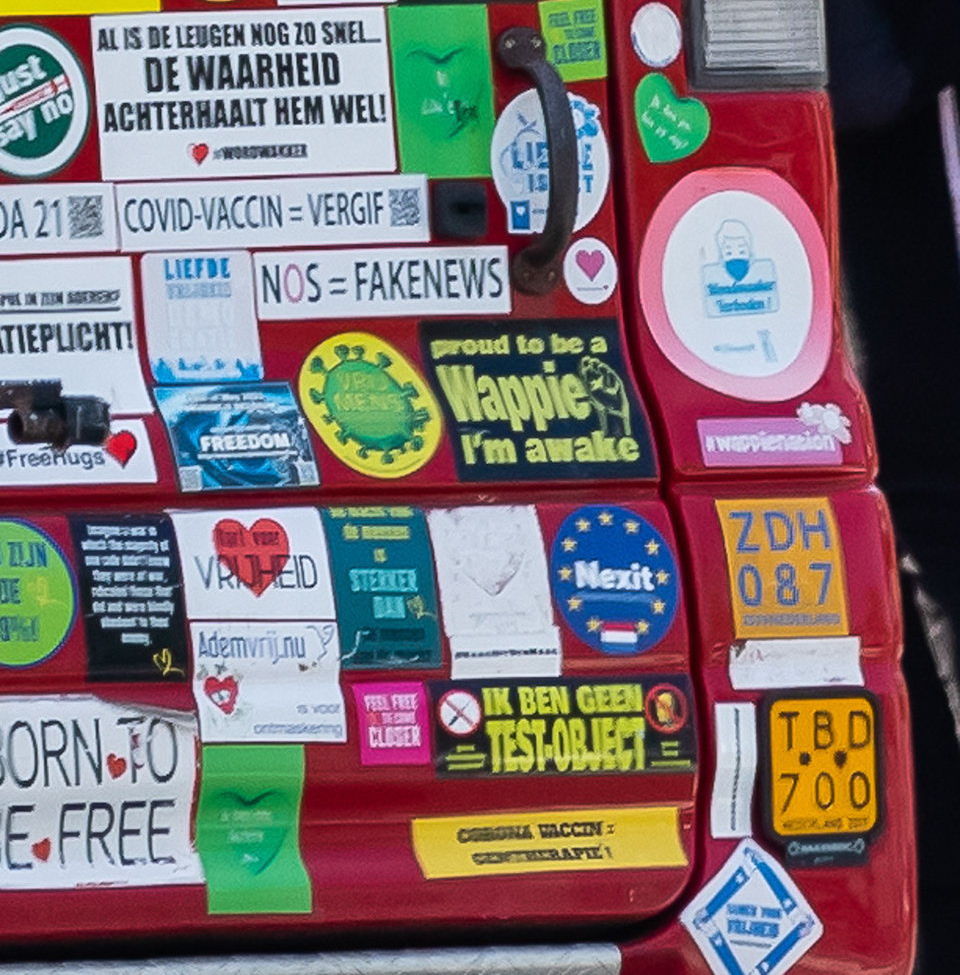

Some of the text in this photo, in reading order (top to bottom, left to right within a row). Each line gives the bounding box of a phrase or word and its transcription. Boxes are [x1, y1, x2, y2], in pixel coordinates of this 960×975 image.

[97, 27, 119, 52] AL
[123, 27, 140, 51] IS
[148, 26, 171, 50] DE
[175, 24, 242, 50] LEUGEN
[251, 22, 290, 47] NOG
[294, 22, 317, 46] ZO
[144, 52, 342, 94] DE WAARHEID
[40, 91, 75, 126] no
[103, 93, 387, 134] ACHTERHAALT HEM WEL!
[32, 198, 64, 239] 21
[124, 194, 283, 234] COVID-VACCIN
[308, 190, 386, 226] VERGIF
[163, 257, 232, 281] LIEFDE
[261, 263, 322, 304] NOS
[354, 256, 503, 302] FAKENEWS
[430, 333, 608, 359] proud to be a
[435, 359, 591, 432] Wappie
[199, 433, 292, 452] FREEDOM
[461, 430, 640, 465] I'm awake
[705, 429, 837, 454] #wappienation
[729, 509, 831, 553] ZDH
[7, 540, 49, 568] ZIJN
[193, 554, 319, 591] VRIJHEID
[574, 560, 656, 592] Nexit
[736, 562, 833, 607] 087
[197, 629, 307, 665] Ademvrij.nu
[482, 682, 644, 716] IK BEN GEEN
[117, 716, 178, 785] TO
[56, 799, 178, 869] FREE
